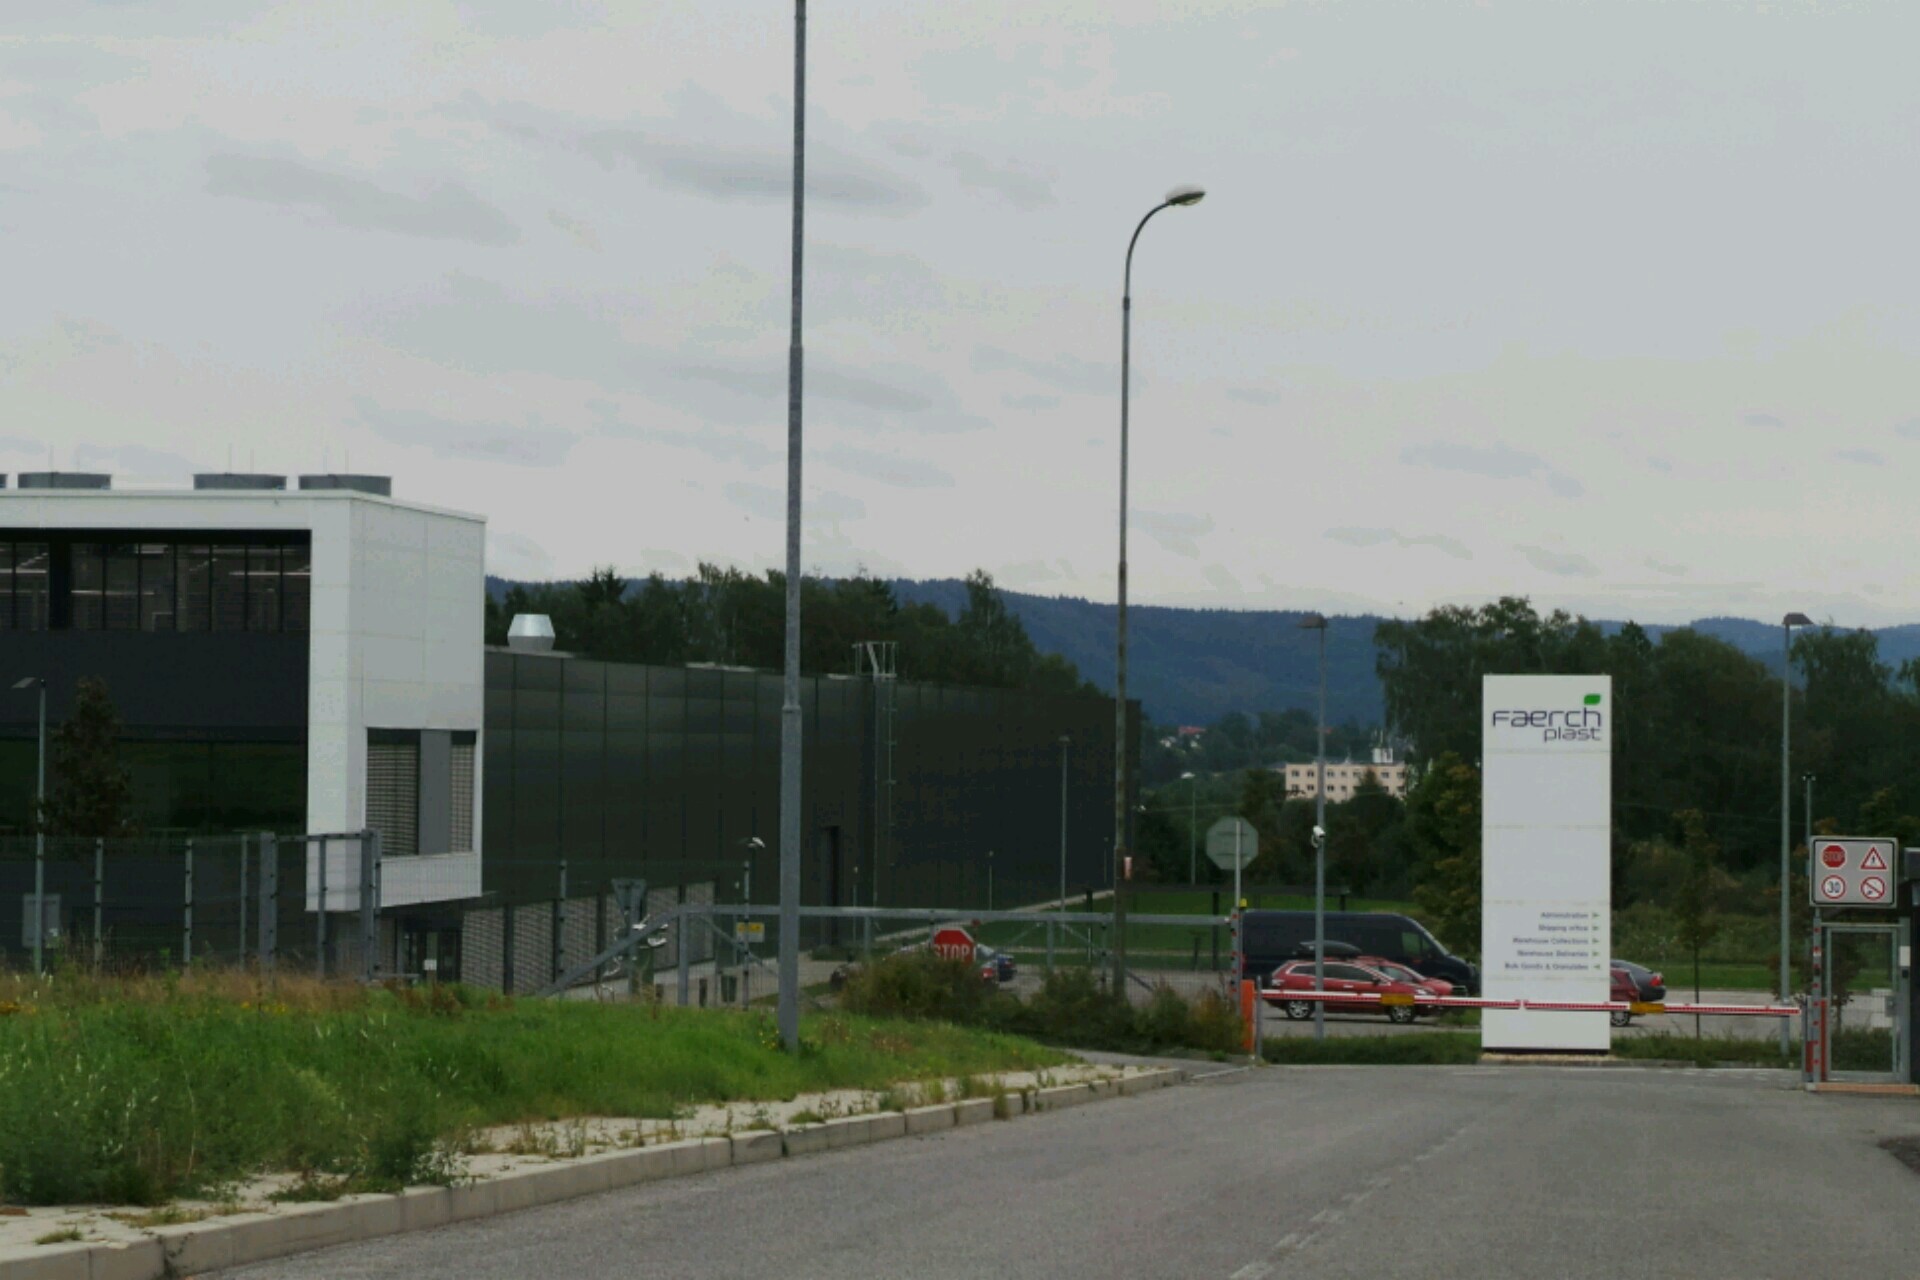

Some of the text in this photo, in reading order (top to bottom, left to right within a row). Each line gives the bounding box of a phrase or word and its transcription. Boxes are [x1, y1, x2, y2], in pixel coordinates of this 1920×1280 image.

[1492, 706, 1602, 728] Faerch
[1544, 726, 1601, 743] plast
[1538, 924, 1567, 932] Shipping
[1517, 949, 1553, 957] Warehouse
